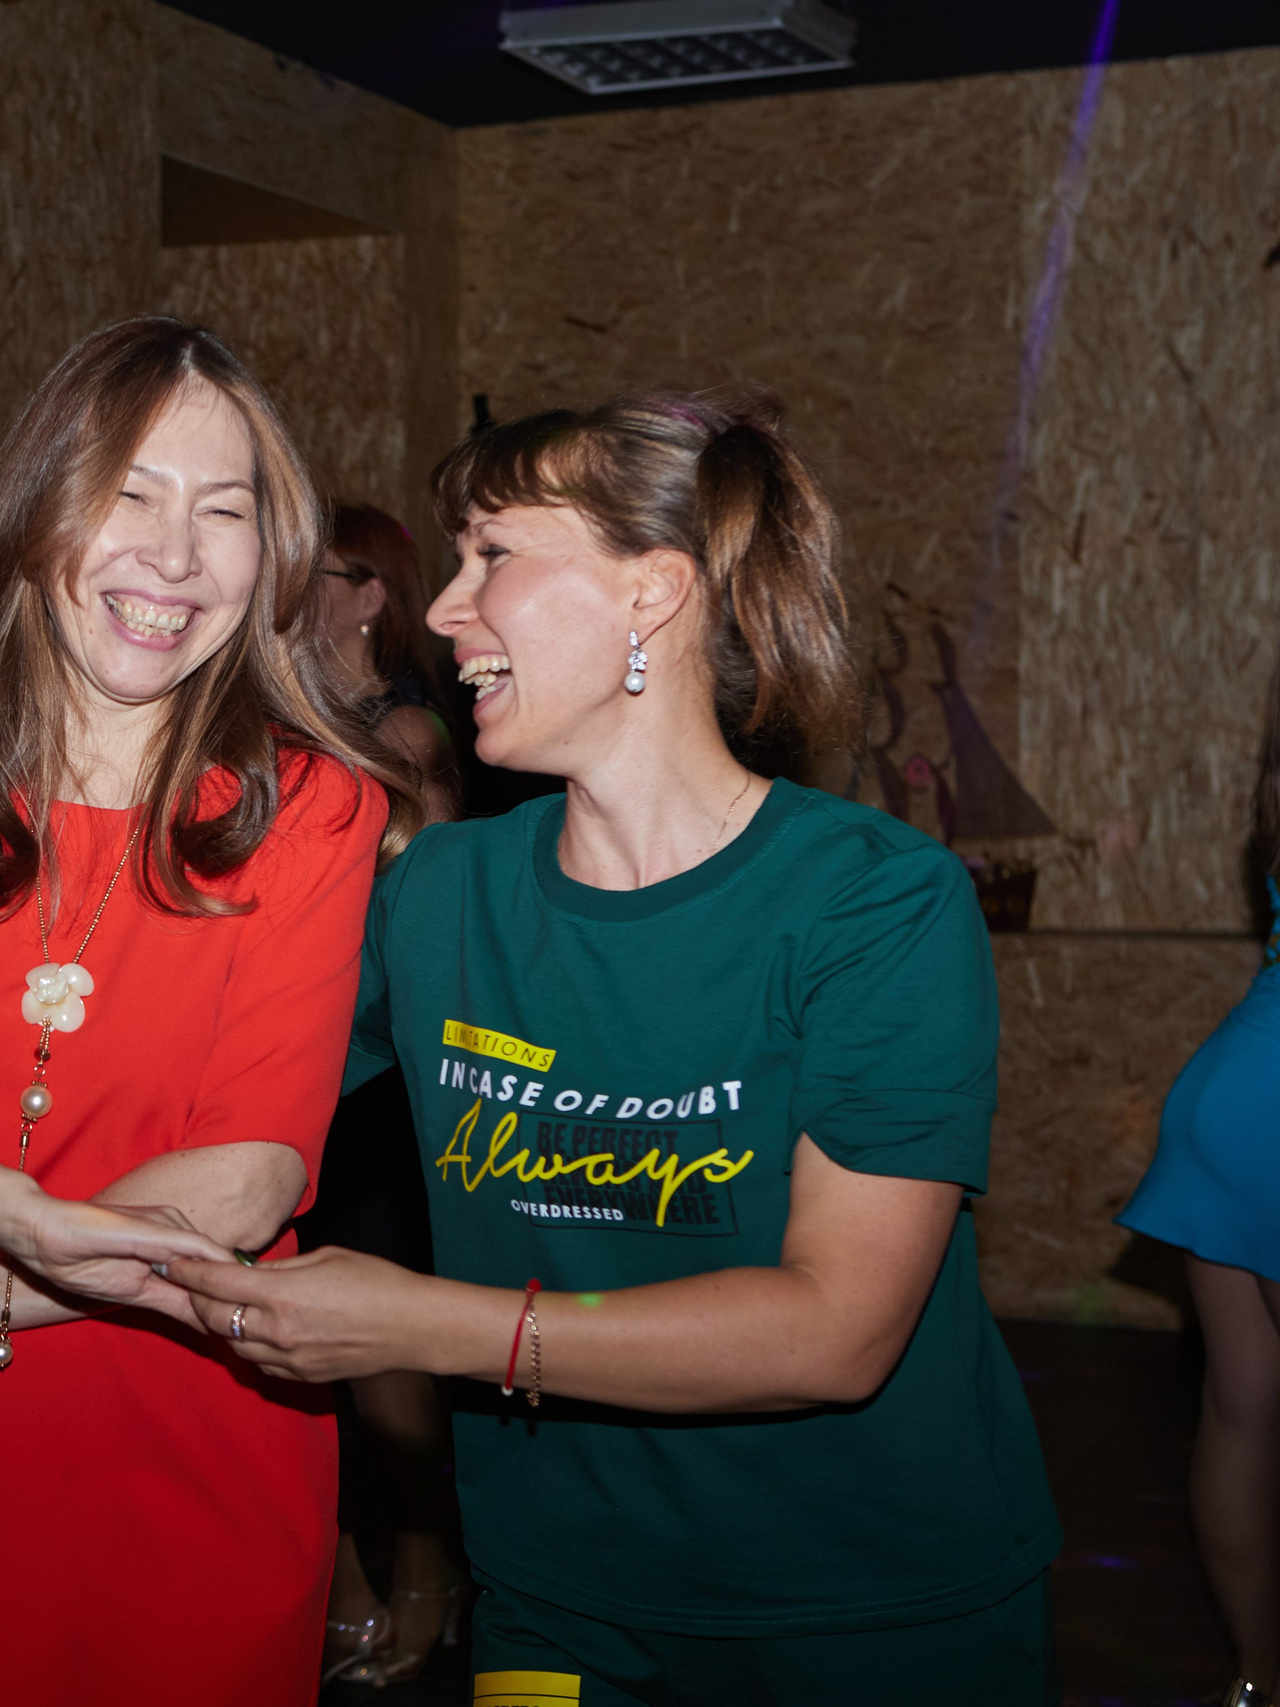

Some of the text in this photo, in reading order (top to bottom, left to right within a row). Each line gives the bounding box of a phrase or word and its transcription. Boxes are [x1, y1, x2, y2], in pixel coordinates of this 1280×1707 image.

[446, 1024, 551, 1067] LIMTATIONS
[553, 1090, 609, 1115] OF
[615, 1080, 742, 1120] DOUBT
[537, 1121, 679, 1162] BE PERFECT
[435, 1098, 754, 1227] Always
[510, 1199, 624, 1221] OVERDRESSED
